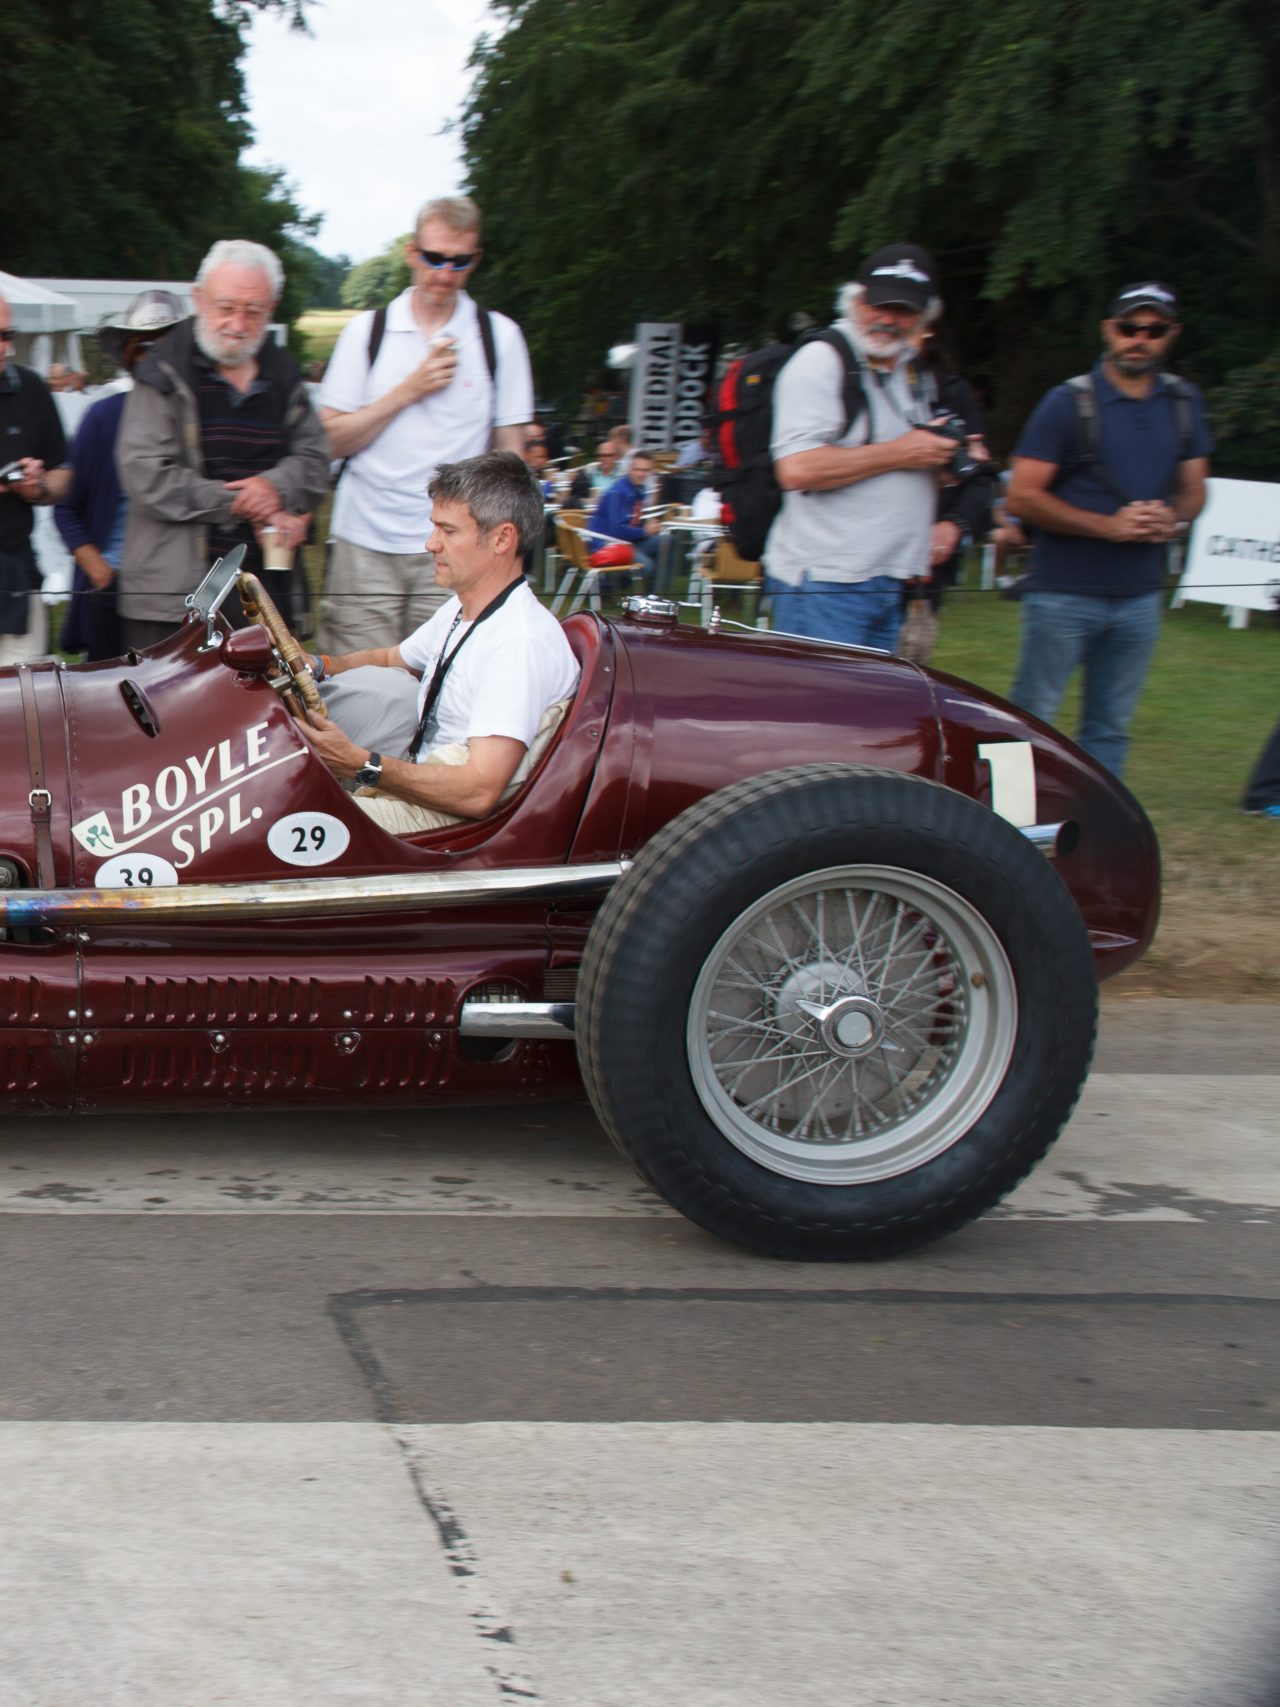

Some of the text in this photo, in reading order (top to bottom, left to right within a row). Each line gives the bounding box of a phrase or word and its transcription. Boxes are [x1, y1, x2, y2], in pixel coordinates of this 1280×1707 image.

[640, 328, 678, 450] THEDRAL
[121, 721, 271, 835] BOYLE
[171, 793, 263, 869] SPL.
[291, 825, 326, 853] 29
